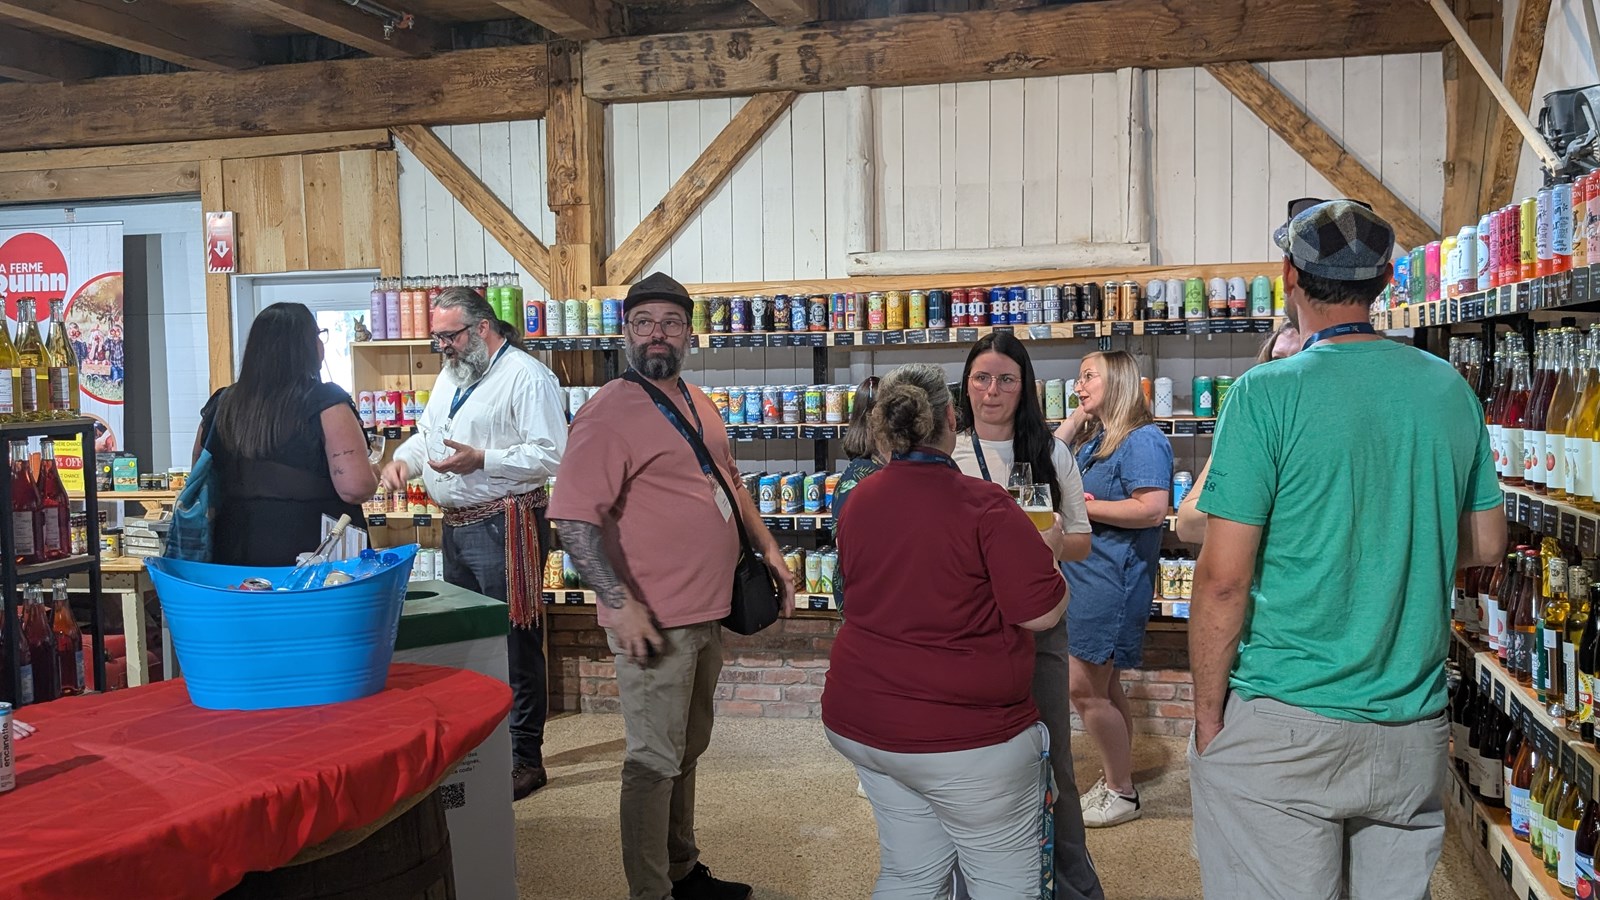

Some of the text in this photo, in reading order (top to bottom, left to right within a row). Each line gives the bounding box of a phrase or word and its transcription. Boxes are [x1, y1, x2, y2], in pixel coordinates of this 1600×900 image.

[10, 261, 44, 274] FERME
[968, 301, 985, 316] 40
[65, 457, 83, 467] OFF
